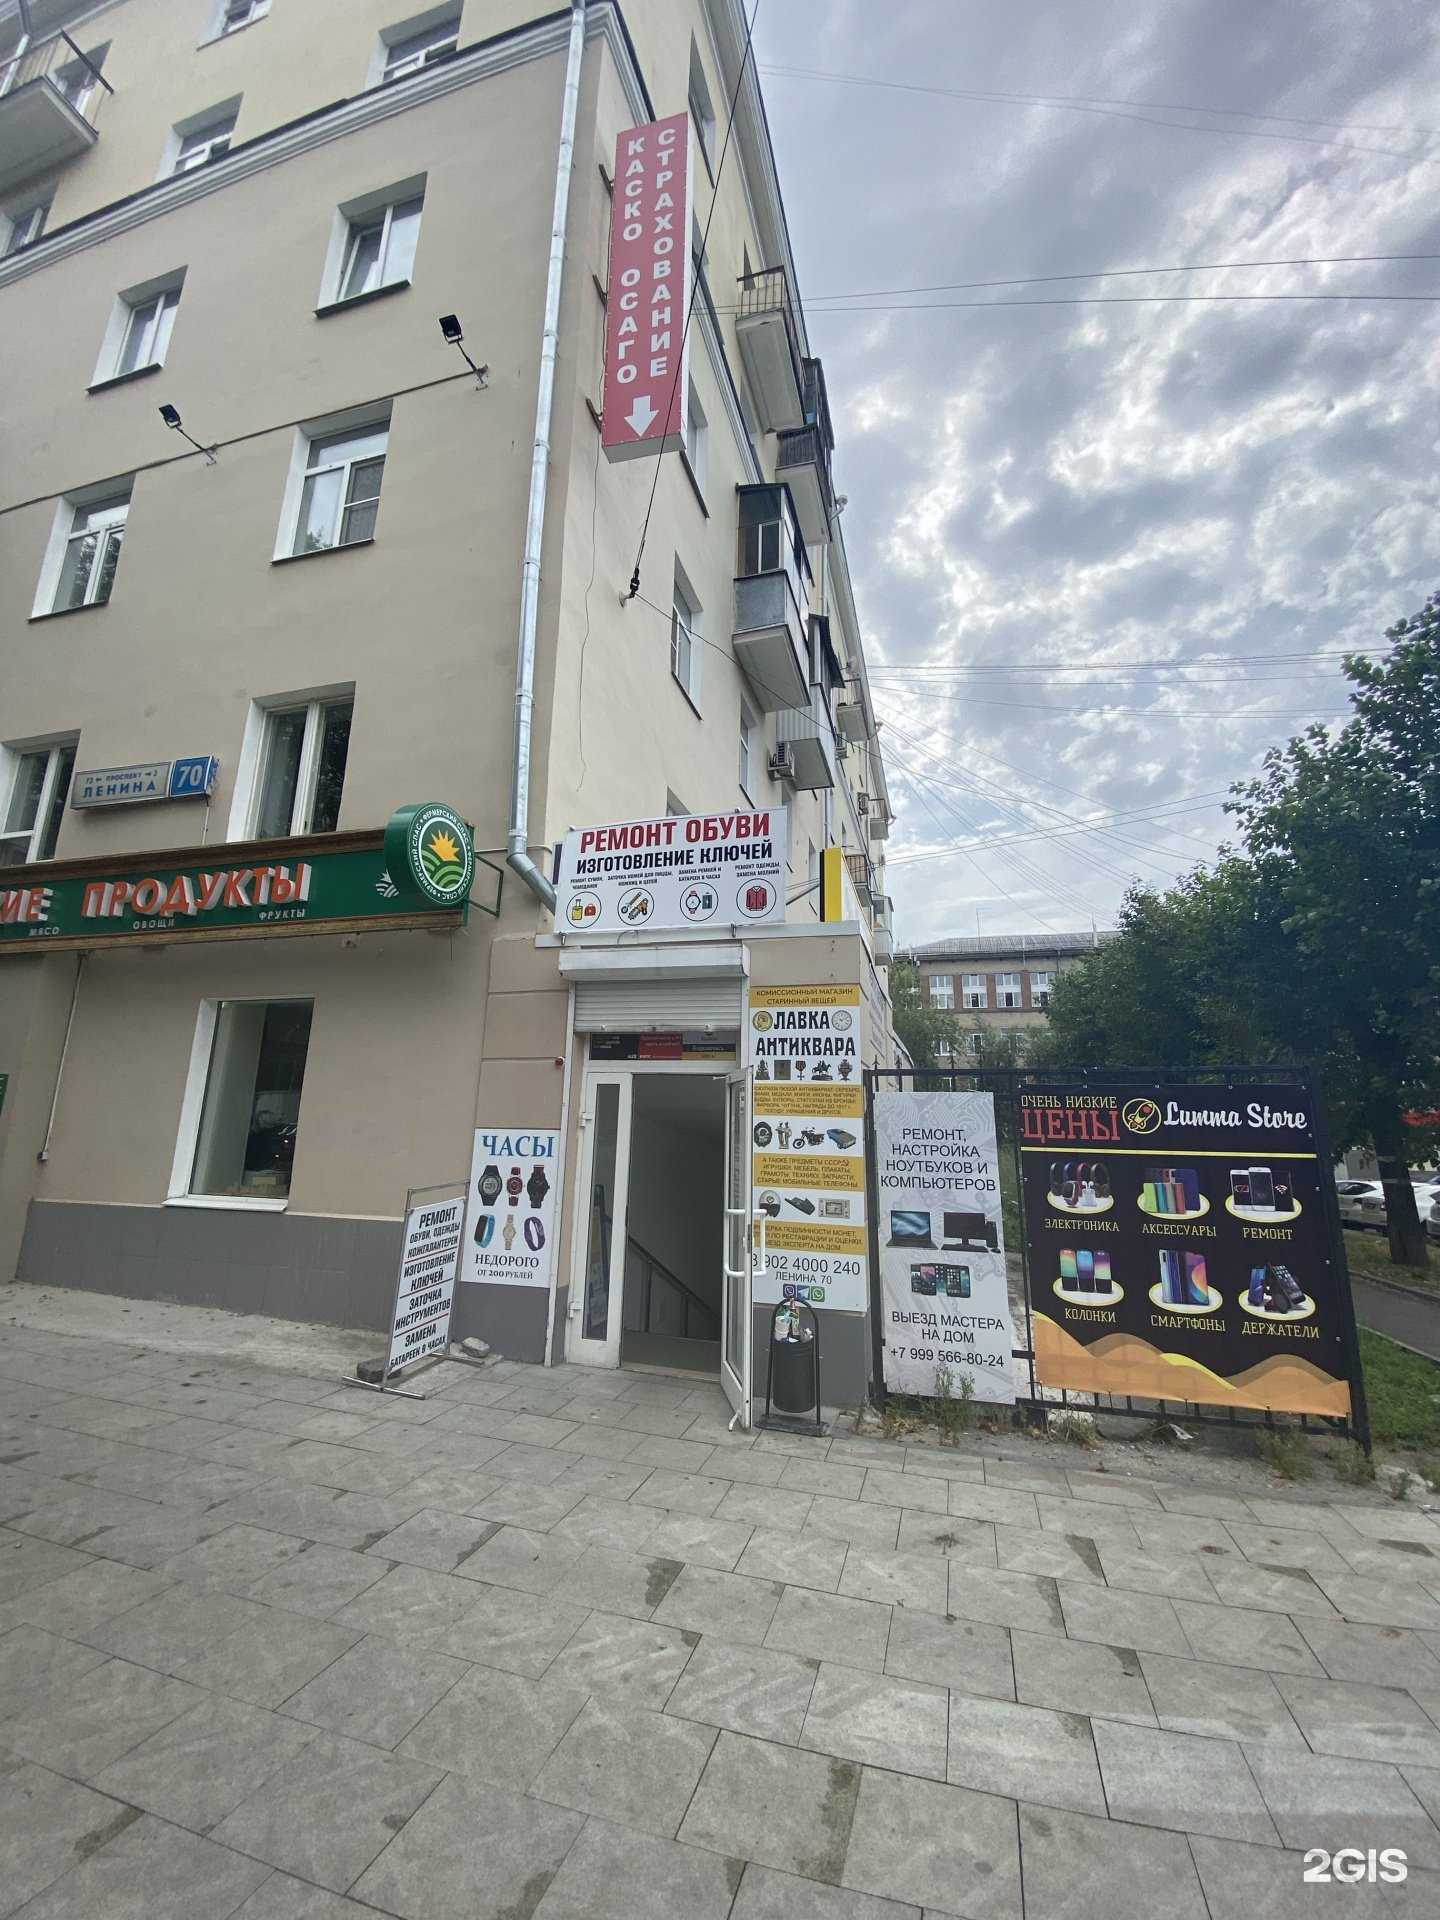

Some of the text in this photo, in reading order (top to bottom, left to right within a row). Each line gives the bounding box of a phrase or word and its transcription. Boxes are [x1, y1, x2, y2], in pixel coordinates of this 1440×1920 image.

[616, 137, 645, 384] КАСКО ОСАГО
[650, 128, 676, 378] СТРАХОВАНИЕ
[177, 764, 203, 788] 70
[83, 780, 156, 798] ЛЕНИНА
[580, 812, 770, 854] РЕМОНТ ОБУВИ
[576, 838, 773, 875] ИЗГОТОВЛЕНИЕ КЛЮЧЕЙ
[81, 863, 313, 919] ПРОДУКТЫ
[28, 908, 306, 937] МЯСО ОВОЩИ ФРУКТЫ
[756, 987, 853, 997] КОМИССИОННЫЙ МАГАЗИН
[811, 996, 837, 1005] ВЕЩЕЙ
[773, 1010, 830, 1029] ЛАВКА
[755, 1037, 856, 1056] АНТИКВАРА
[1020, 1095, 1118, 1109] ОЧЕНЬ НИЗКИЕ
[1021, 1108, 1121, 1143] ЦЕНЫ
[1163, 1101, 1307, 1129] Lumma Store
[902, 1128, 967, 1142] РЕМОНТ,
[482, 1135, 555, 1157] ЧАСЫ
[891, 1143, 980, 1158] НАСТРОЙКА
[886, 1159, 988, 1175] НОУТБУКОВ И
[880, 1175, 996, 1191] КОМПЬЮТЕРОВ
[419, 1206, 458, 1229] РЕМОНТ
[433, 1222, 461, 1238] ОДЕЖДЫ
[1044, 1218, 1293, 1241] ЭЛЕКТРОНИКА АКСЕССУАРЫ РЕМОНТ
[404, 1251, 456, 1279] ИЗГОТОВЛЕНИЕ
[474, 1253, 540, 1268] НЕДОРОГО
[792, 1257, 829, 1273] 4000
[833, 1260, 861, 1276] 240
[410, 1267, 444, 1292] КЛЮЧЕЙ
[477, 1269, 533, 1280] ОТ 200 РУБЛЕЙ
[775, 1271, 832, 1285] ЛЕНИНА 70
[409, 1287, 442, 1311] ЗАТОЧКА
[395, 1298, 451, 1332] ИНСТРУМЕНТОВ
[892, 1311, 1005, 1330] ВЫЕЗД МАСТЕРА
[1065, 1308, 1319, 1339] КОЛОНКИ СМАРТФОНЫ ДЕРЖАТЕЛИ
[405, 1323, 437, 1347] ЗАМЕНА
[427, 1335, 446, 1350] ЧАСАХ
[921, 1329, 974, 1344] НА ДОМ
[890, 1347, 1005, 1368] +7 999 566-80-24
